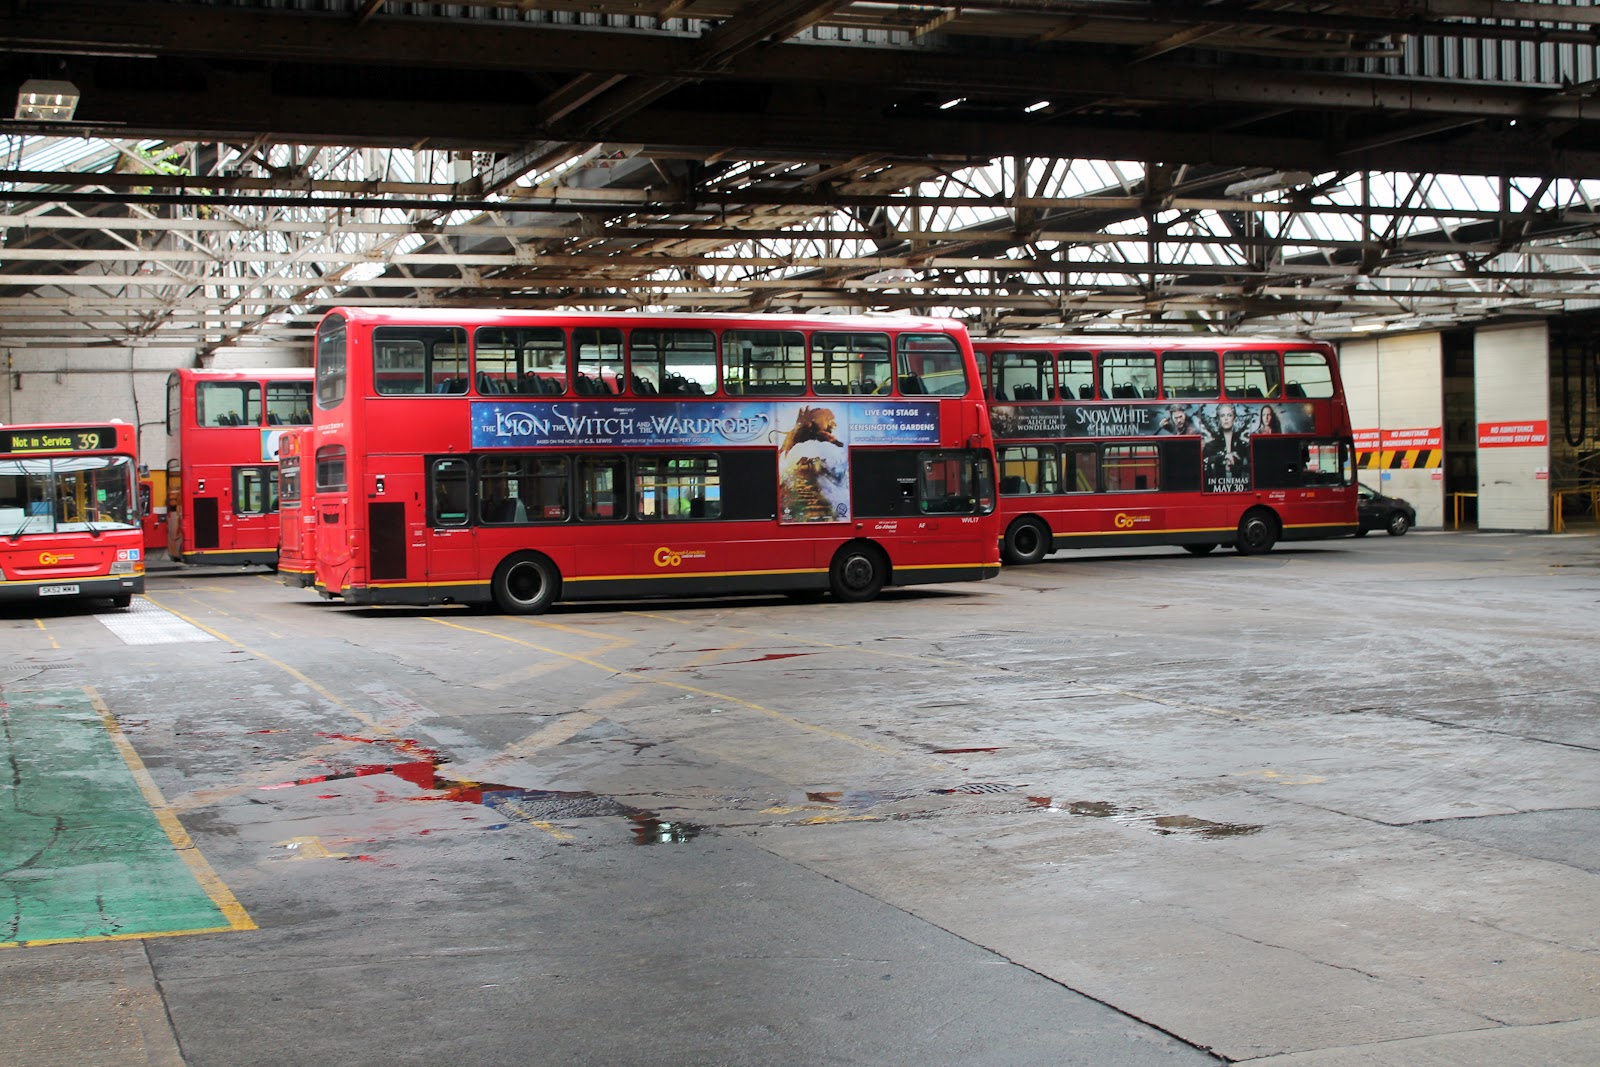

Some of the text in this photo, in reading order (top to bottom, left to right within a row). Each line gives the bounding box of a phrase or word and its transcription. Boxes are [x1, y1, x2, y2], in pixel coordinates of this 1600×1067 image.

[1076, 407, 1149, 424] SNOW WHITE
[495, 411, 549, 437] LION
[552, 405, 634, 436] WITCH
[650, 414, 769, 443] WARDROBE
[849, 423, 935, 431] KENSINGTON GARDENS
[1095, 423, 1139, 436] HUNTSMAN
[1490, 426, 1499, 434] NO
[12, 433, 100, 450] Not in Service 39
[1218, 477, 1249, 485] CINEMAS
[1213, 484, 1244, 493] MAY 30
[653, 546, 682, 567] Go
